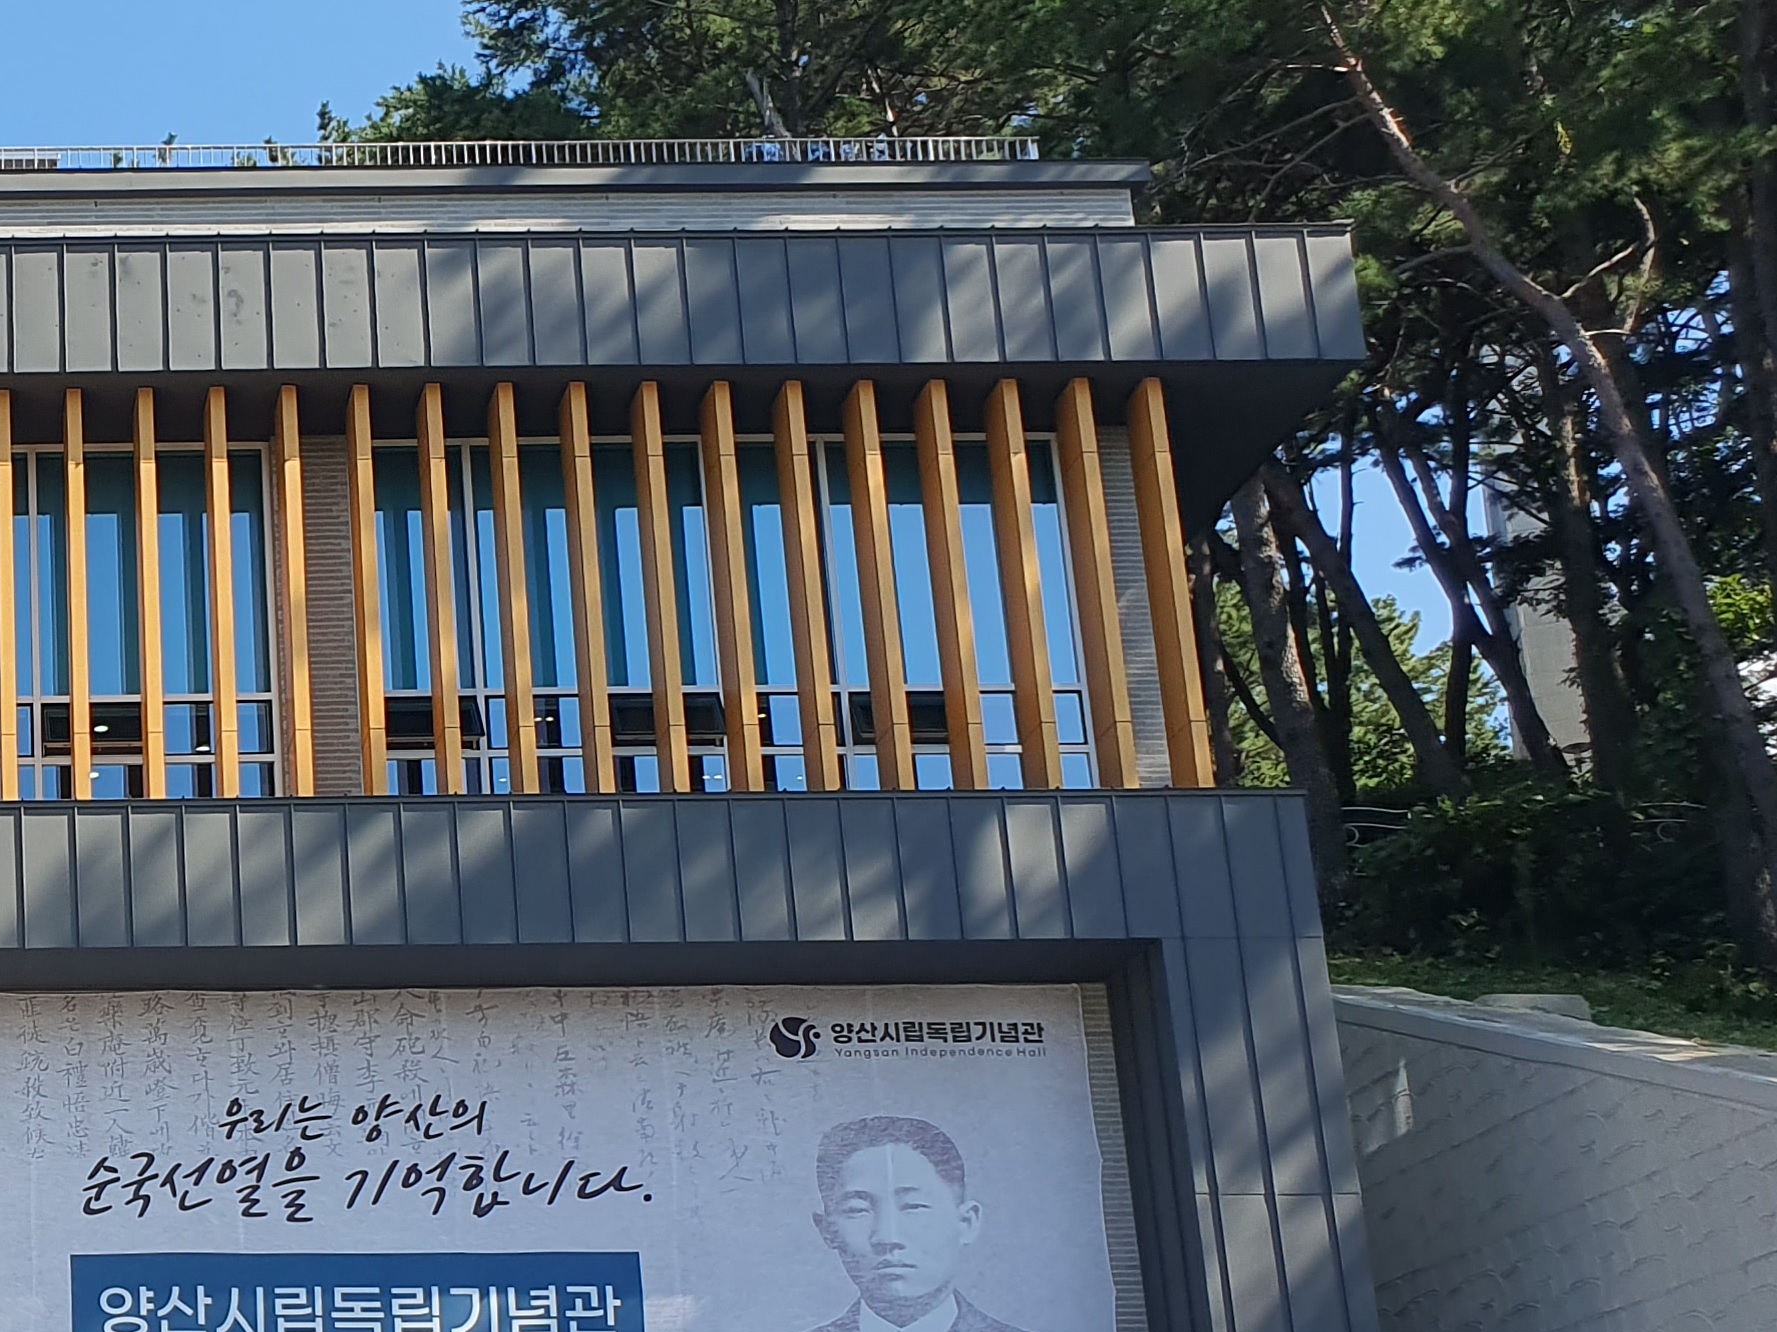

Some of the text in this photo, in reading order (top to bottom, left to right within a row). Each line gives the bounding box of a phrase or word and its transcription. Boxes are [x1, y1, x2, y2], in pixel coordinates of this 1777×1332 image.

[831, 1021, 1045, 1044] 양산시립독립기념관
[834, 1047, 1046, 1059] Yangsan Independence Hall
[218, 1094, 488, 1143] 우리는 양산의
[81, 1146, 654, 1223] 순국선열을 기억합니다.
